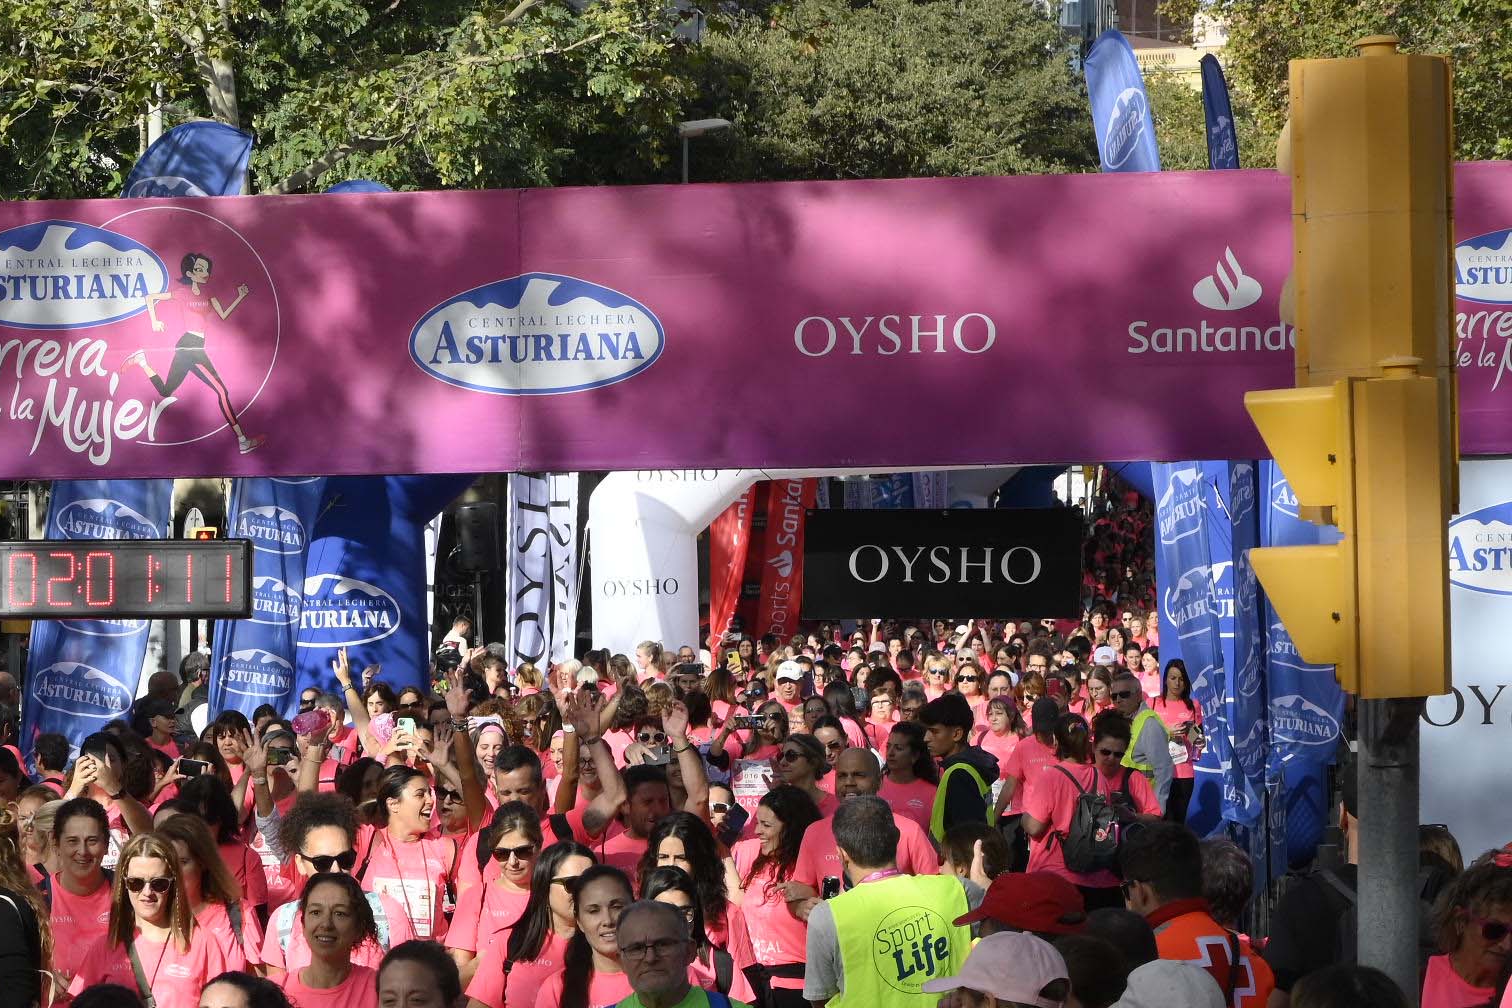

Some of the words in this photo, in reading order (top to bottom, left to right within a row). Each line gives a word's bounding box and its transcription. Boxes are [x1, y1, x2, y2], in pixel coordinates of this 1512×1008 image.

[72, 256, 144, 267] LECHERA
[468, 315, 547, 329] CENTRAL
[554, 313, 636, 327] LECHERA
[793, 312, 998, 358] OYSHO
[428, 320, 645, 365] ASTURIANA
[1455, 343, 1472, 368] e
[1478, 340, 1496, 368] la
[9, 380, 34, 421] la
[29, 373, 179, 467] Mujer
[847, 544, 1042, 586] OYSHO
[603, 578, 679, 598] OYSHO
[37, 675, 123, 711] ASTURIANA
[876, 911, 935, 955] Sport
[892, 933, 950, 982] Life
